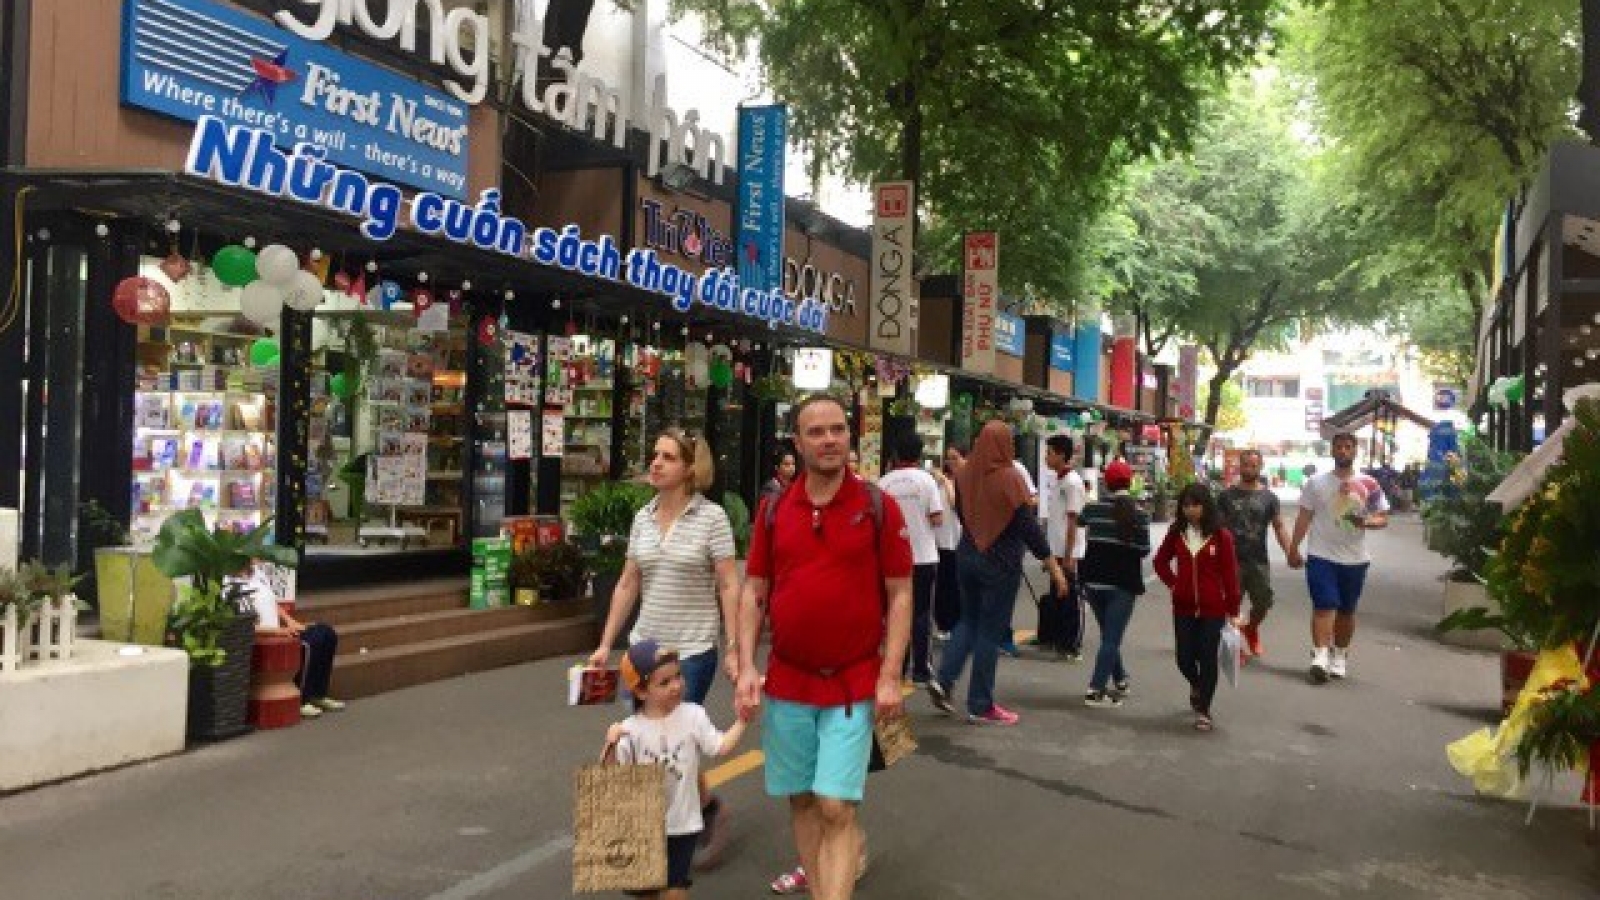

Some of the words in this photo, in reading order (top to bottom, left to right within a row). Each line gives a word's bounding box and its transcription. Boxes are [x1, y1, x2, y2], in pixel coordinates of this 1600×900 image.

[143, 68, 217, 111] Where
[221, 95, 290, 134] there's
[294, 124, 306, 139] a
[314, 129, 346, 150] will
[364, 143, 419, 174] there's
[422, 164, 431, 177] a
[437, 168, 466, 191] way
[300, 61, 381, 126] First
[385, 92, 469, 156] News
[185, 114, 403, 241] Những
[410, 187, 525, 257] cuốn
[533, 223, 621, 282] sách
[625, 248, 696, 311] thay
[742, 182, 763, 232] First
